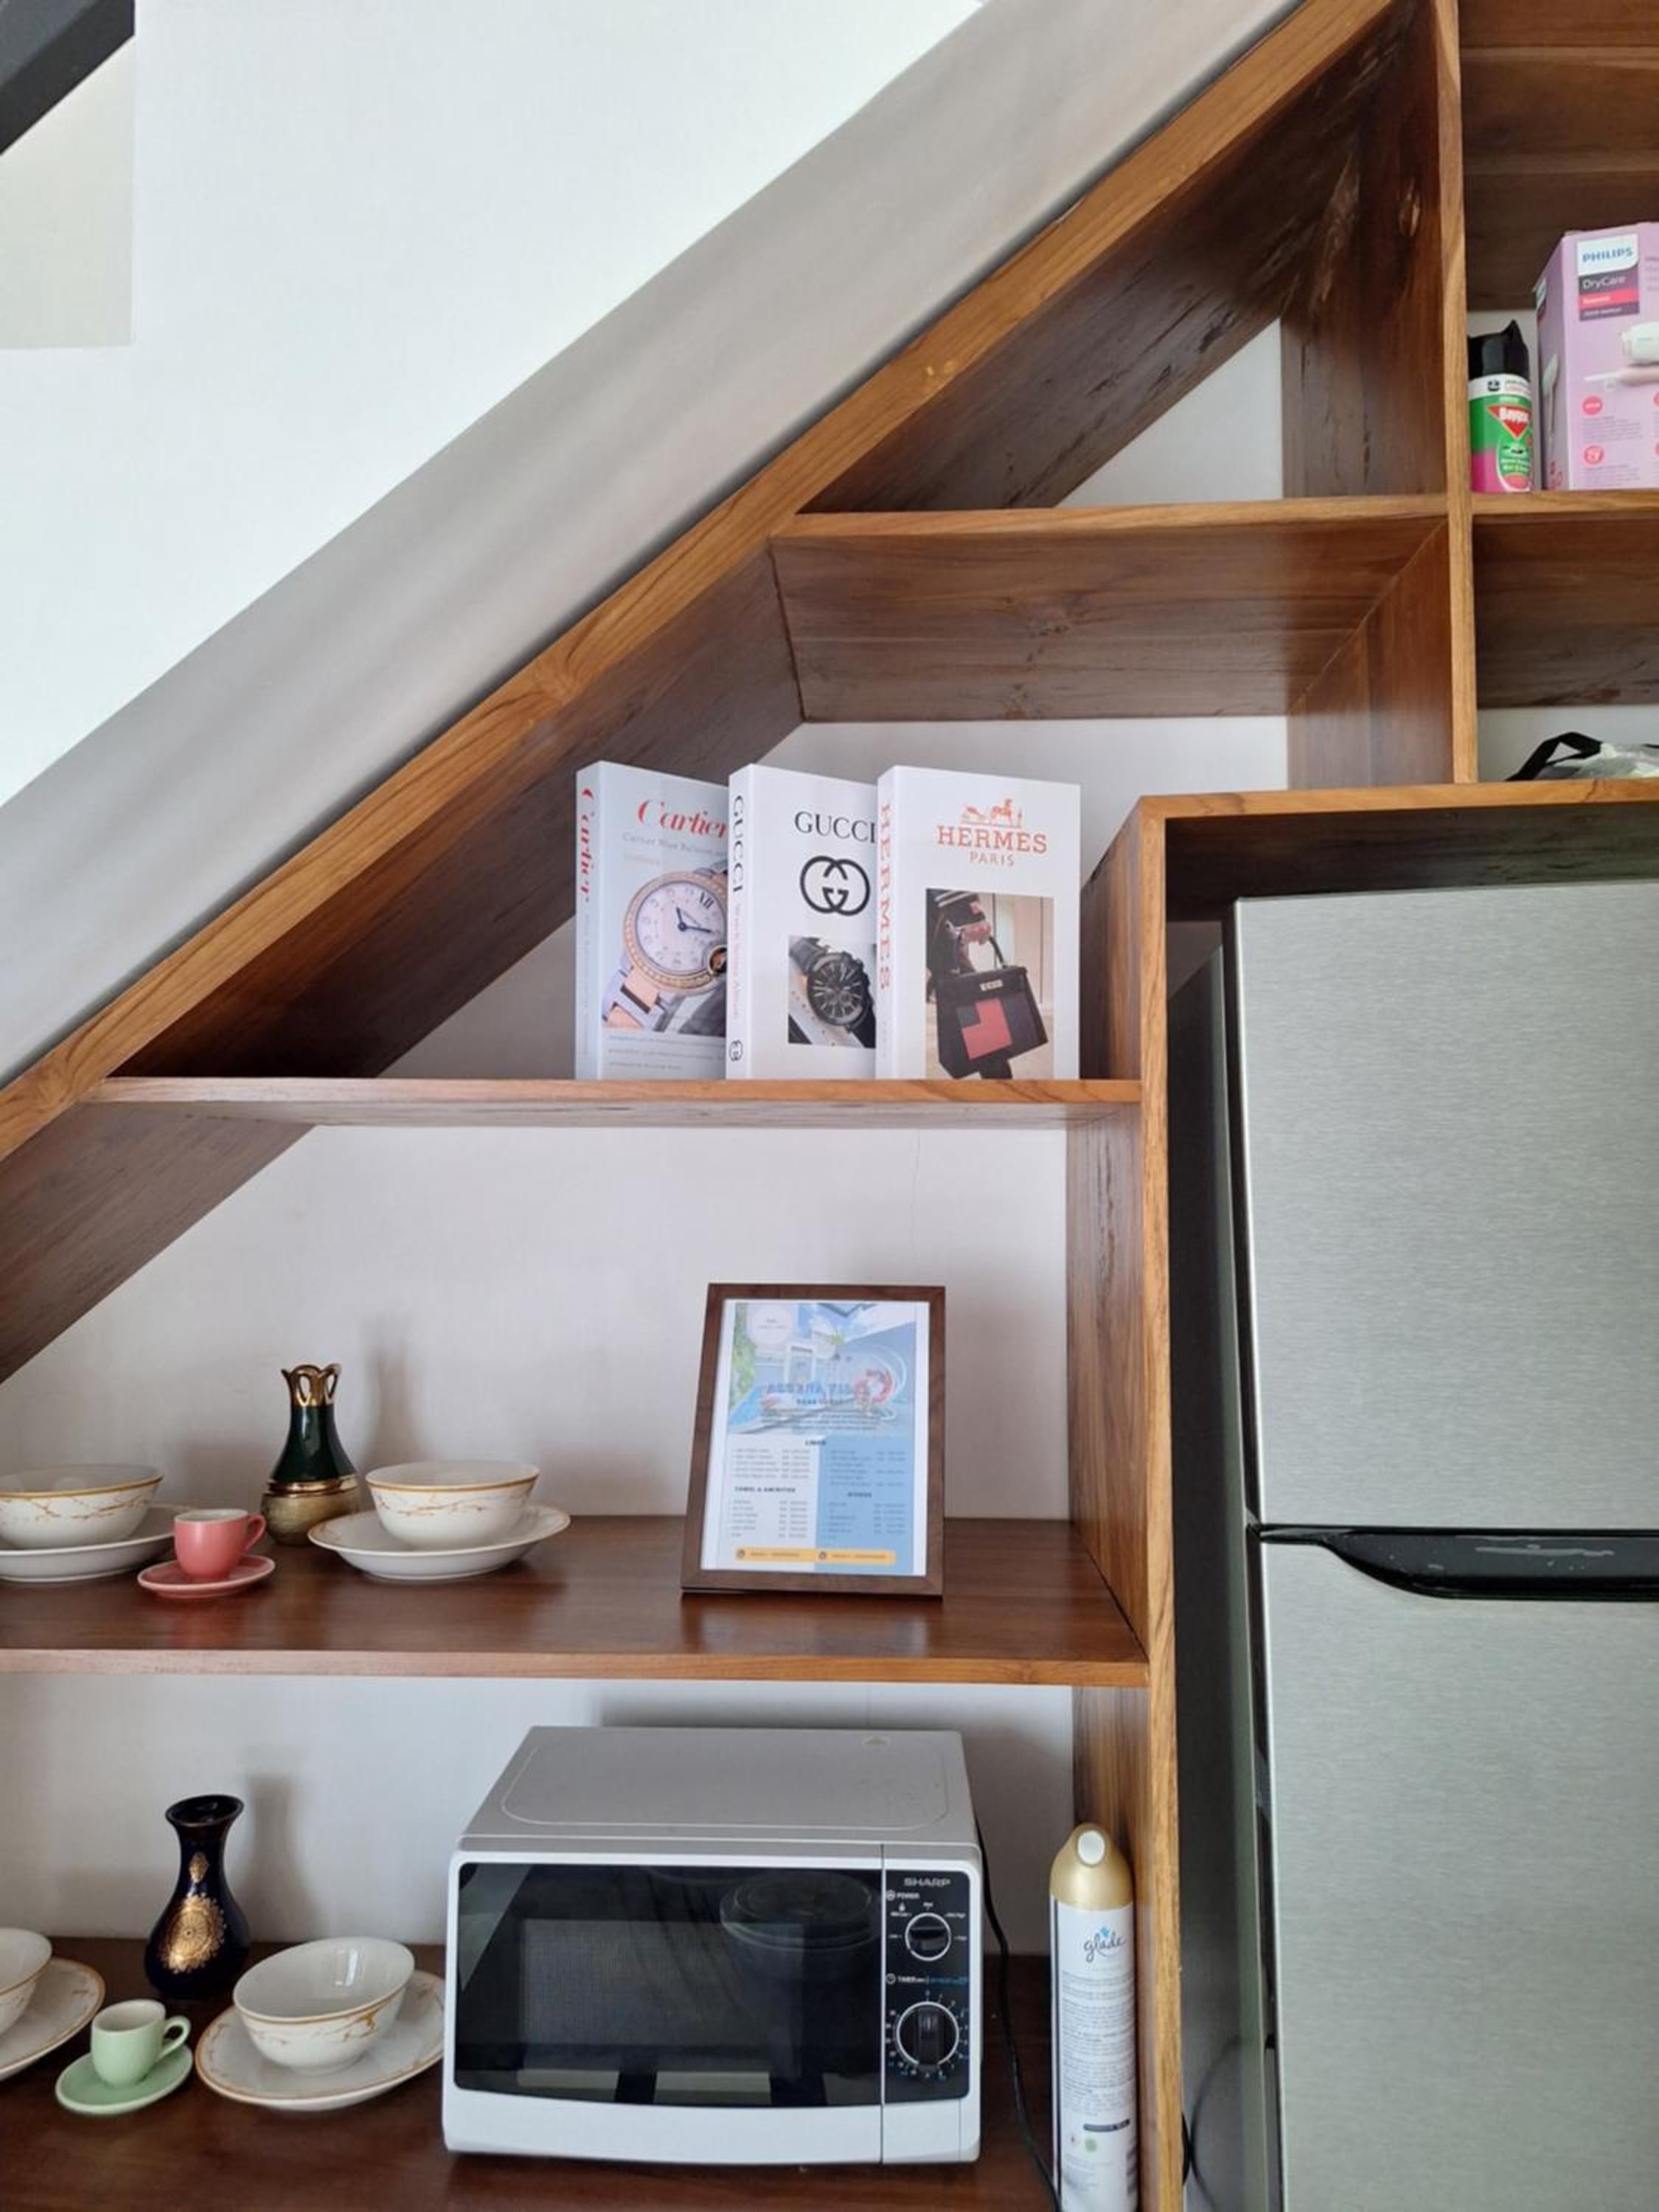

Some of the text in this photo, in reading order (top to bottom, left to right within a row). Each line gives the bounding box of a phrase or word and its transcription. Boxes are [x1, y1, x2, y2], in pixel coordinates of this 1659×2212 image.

[1582, 247, 1633, 262] PHILIPS
[1582, 276, 1626, 289] DryCare
[637, 800, 728, 838] Cartier
[794, 810, 876, 844] GUCCI
[580, 788, 594, 901] Cartier
[731, 795, 744, 892] GUCCI
[936, 825, 1048, 855] HERMES
[969, 852, 1015, 867] PARIS
[878, 802, 891, 990] HERMES
[903, 1877, 951, 1887] SHARP
[1084, 1930, 1127, 1963] glade
